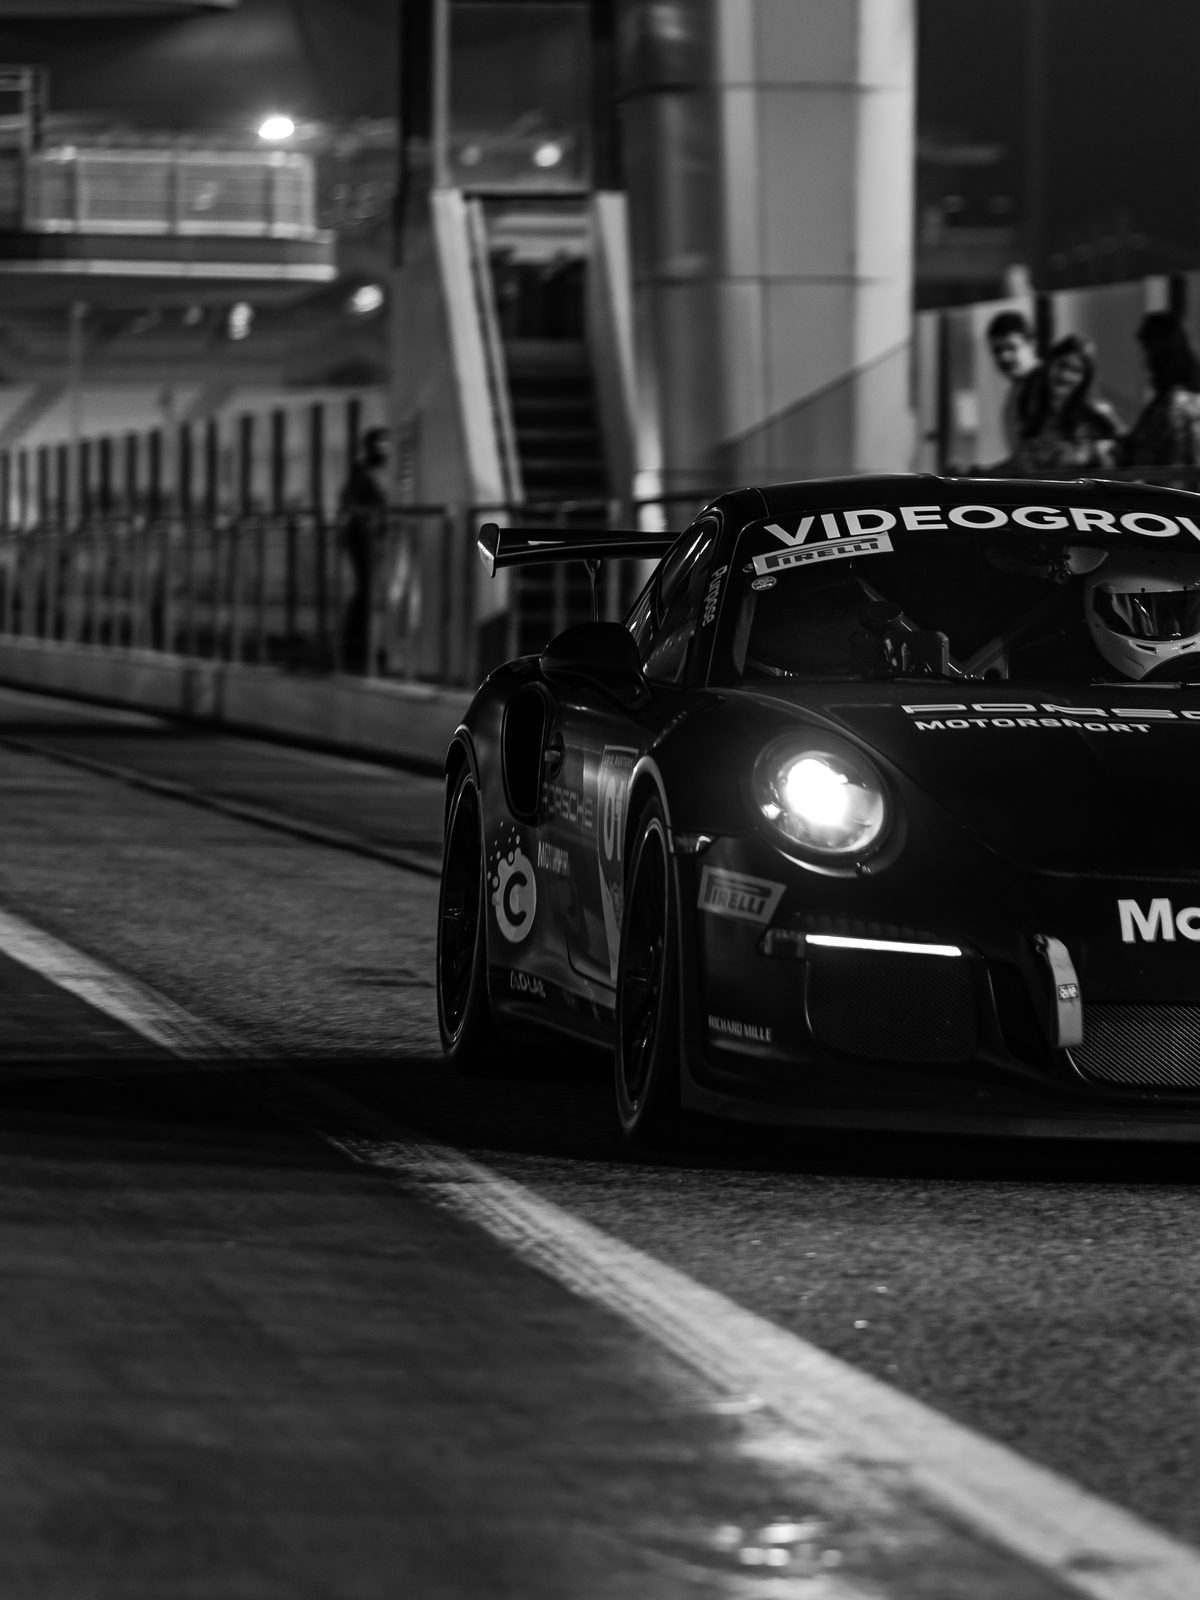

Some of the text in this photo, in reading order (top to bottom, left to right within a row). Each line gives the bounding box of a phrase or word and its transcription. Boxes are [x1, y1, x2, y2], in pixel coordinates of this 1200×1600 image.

[765, 537, 879, 569] PIRELLI
[703, 565, 728, 628] Purpose
[914, 717, 1151, 733] MOTORSPORT
